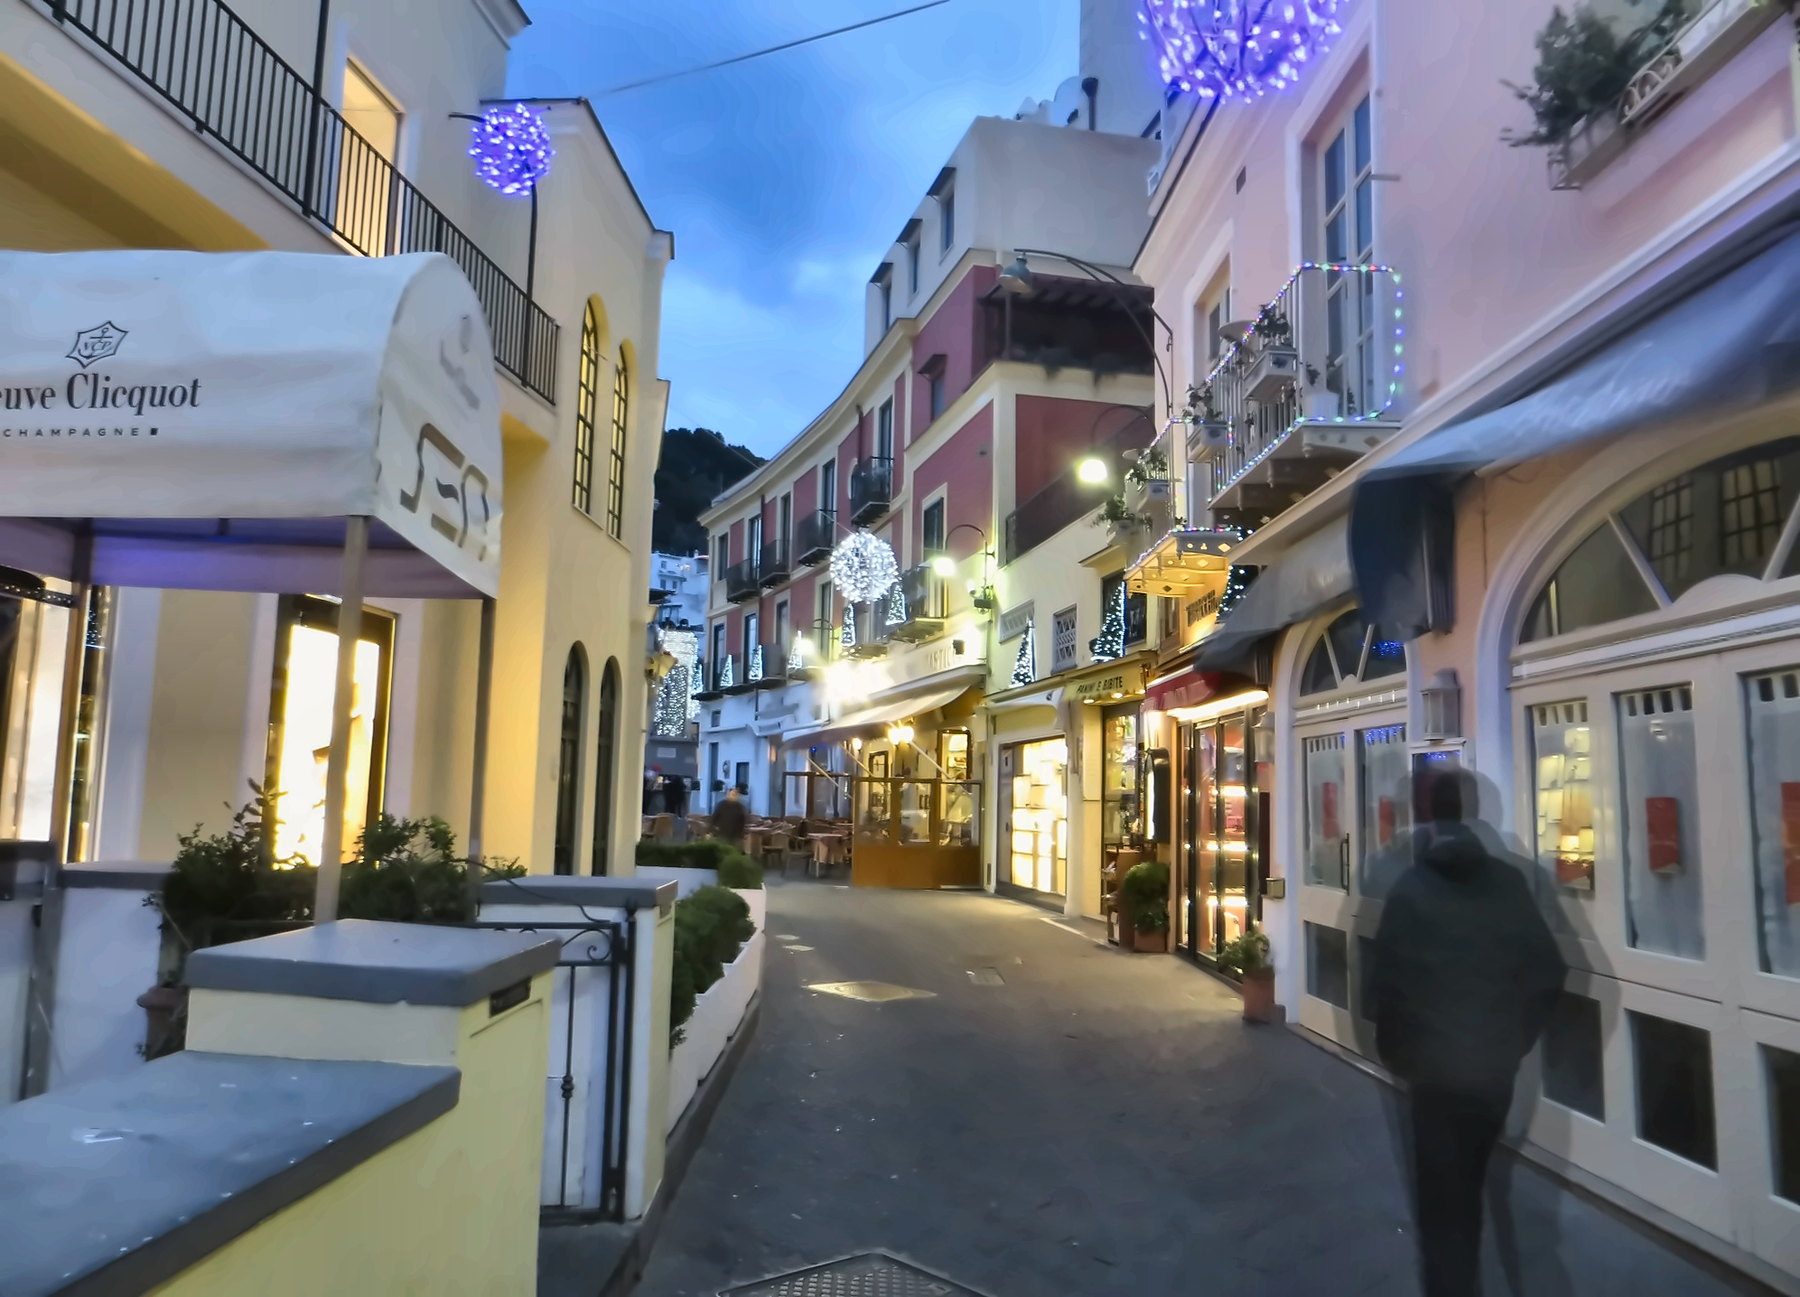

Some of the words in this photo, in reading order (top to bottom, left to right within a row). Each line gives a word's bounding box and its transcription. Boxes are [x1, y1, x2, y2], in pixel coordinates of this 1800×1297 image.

[0, 386, 57, 411] uve
[66, 372, 202, 417] Clicquot
[3, 427, 140, 438] CHAMPAGNE
